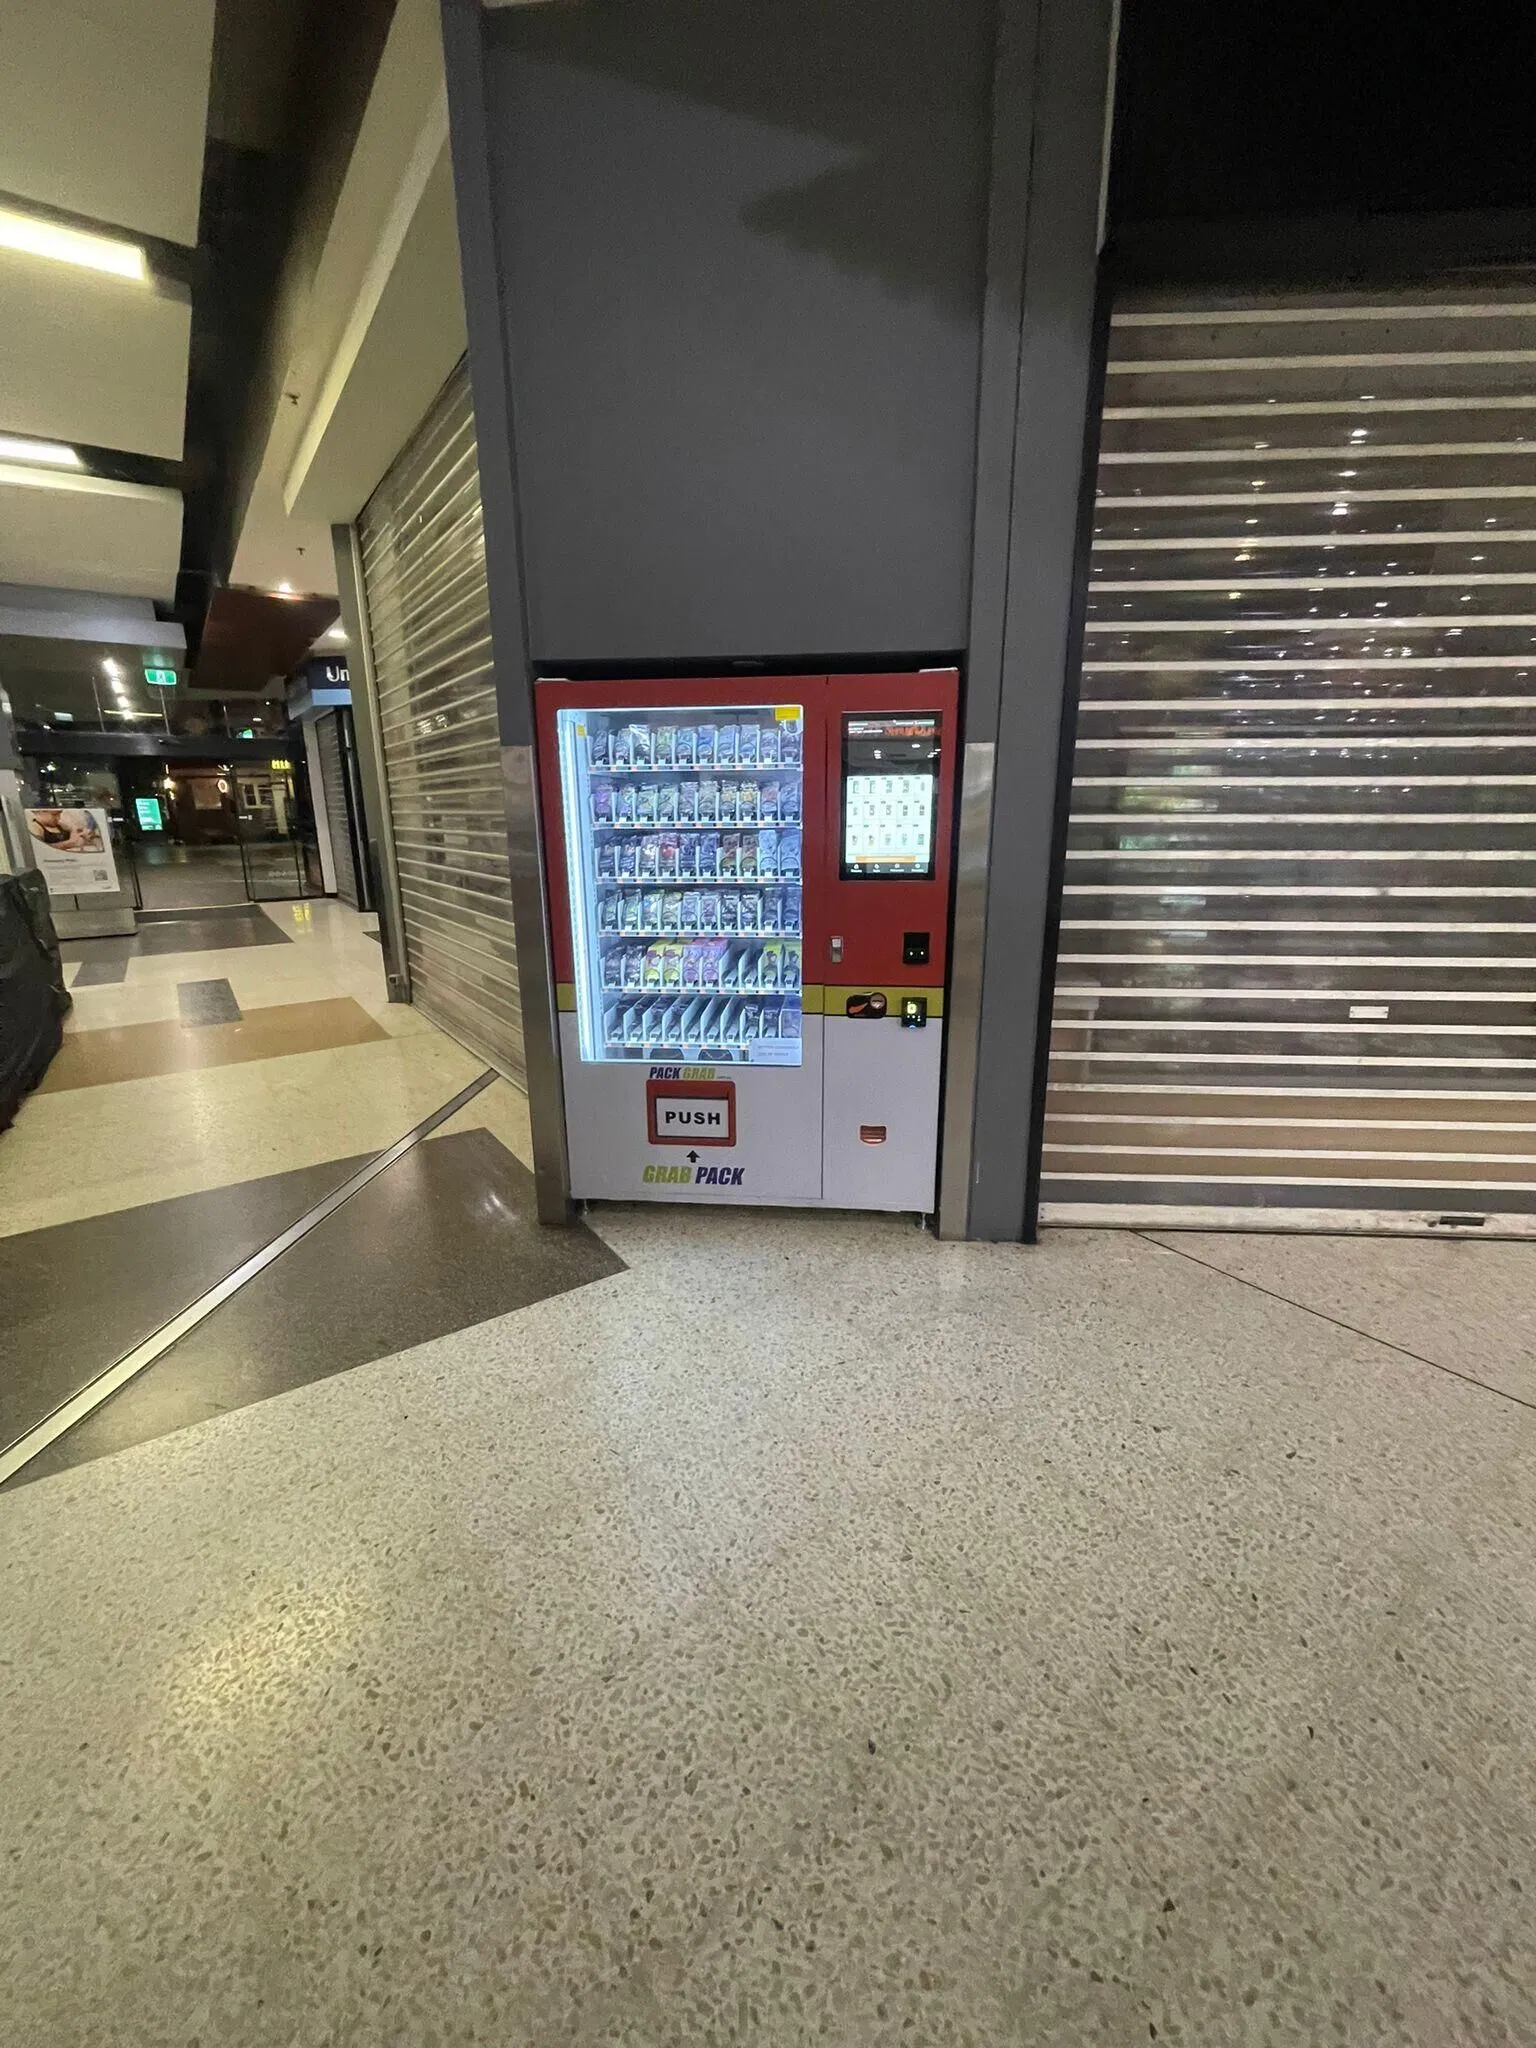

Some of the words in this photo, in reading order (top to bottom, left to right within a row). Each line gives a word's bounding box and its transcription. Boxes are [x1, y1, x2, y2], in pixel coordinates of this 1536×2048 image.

[649, 1066, 681, 1079] PACK
[682, 1066, 716, 1080] GRAB
[665, 1111, 721, 1125] PUSH
[642, 1165, 692, 1184] GRAB
[695, 1166, 745, 1186] PACK
